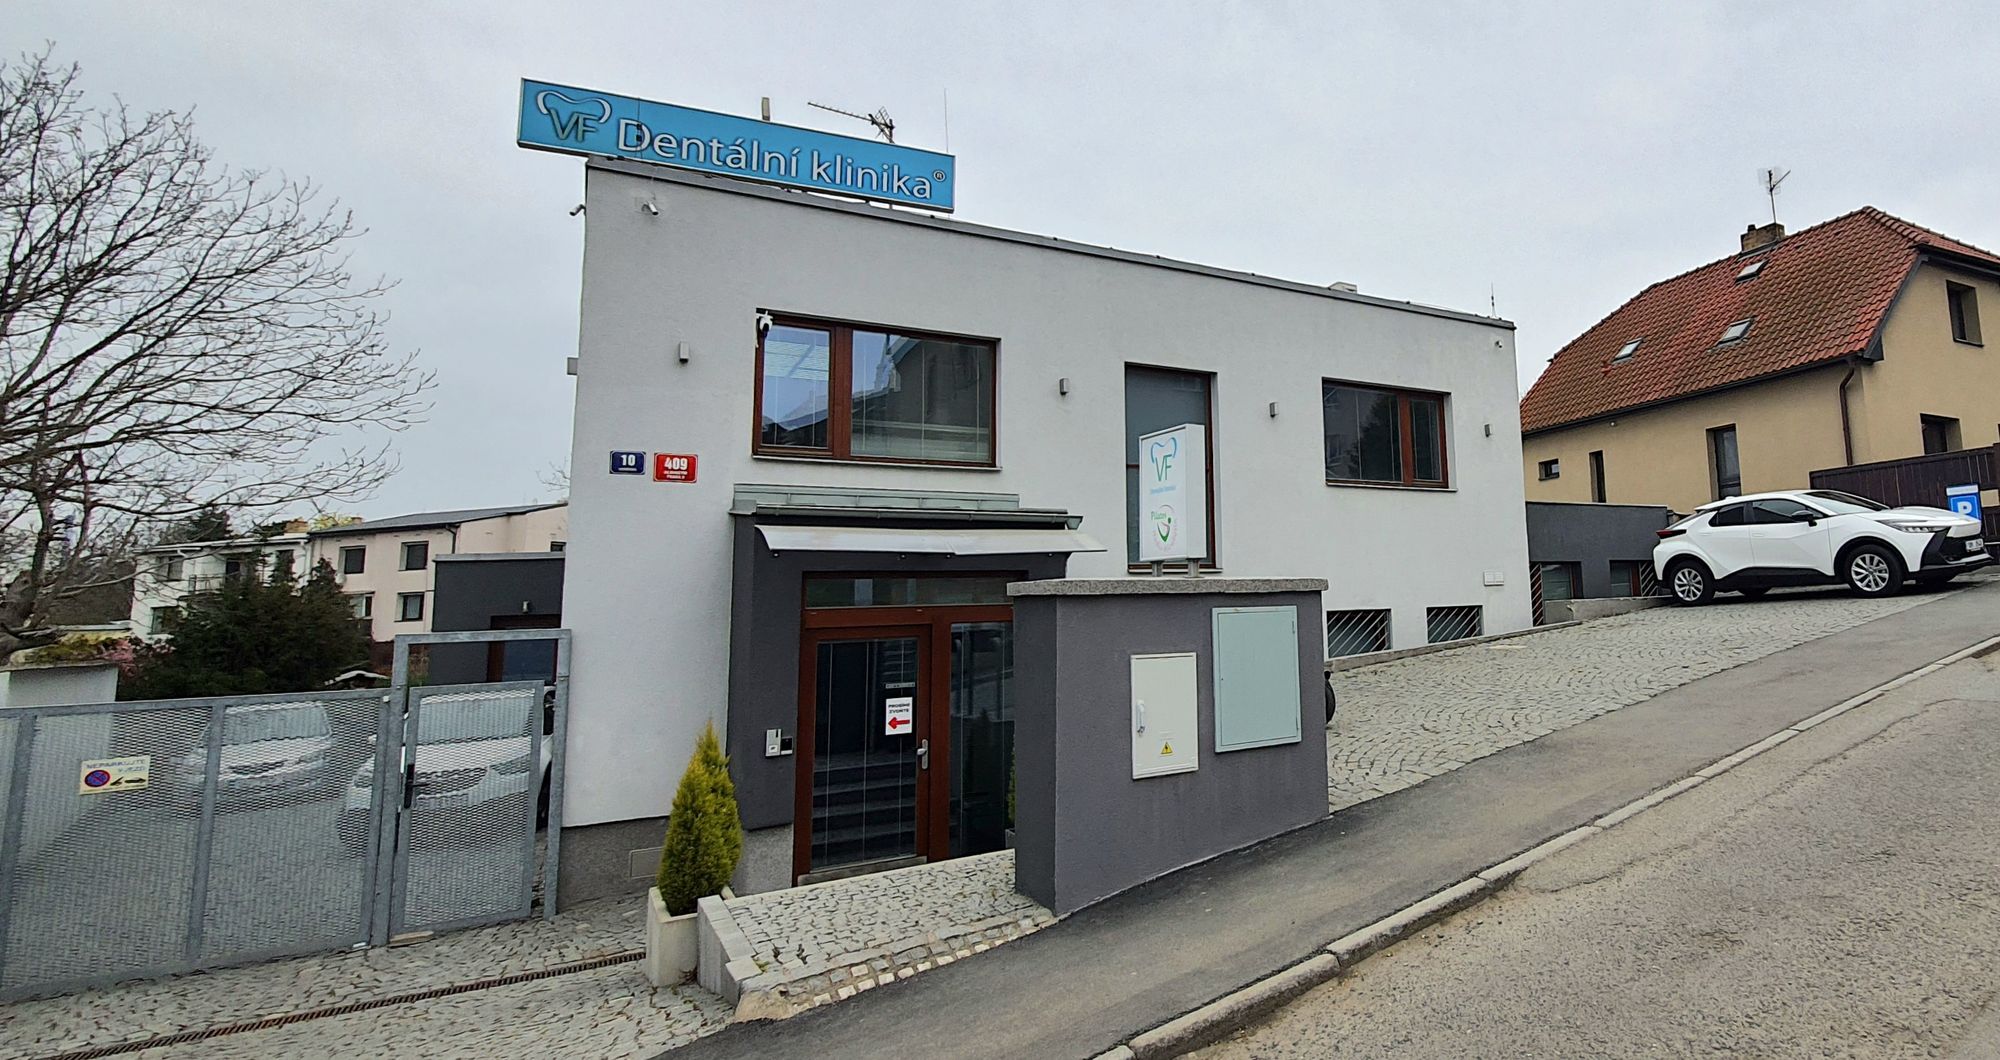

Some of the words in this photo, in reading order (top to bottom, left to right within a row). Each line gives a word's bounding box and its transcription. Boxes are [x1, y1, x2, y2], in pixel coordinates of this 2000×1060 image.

[549, 107, 600, 143] VF
[616, 117, 800, 178] Dentální
[620, 454, 636, 466] 10
[664, 457, 688, 470] 409
[1155, 453, 1173, 482] VF
[1957, 501, 1972, 516] P
